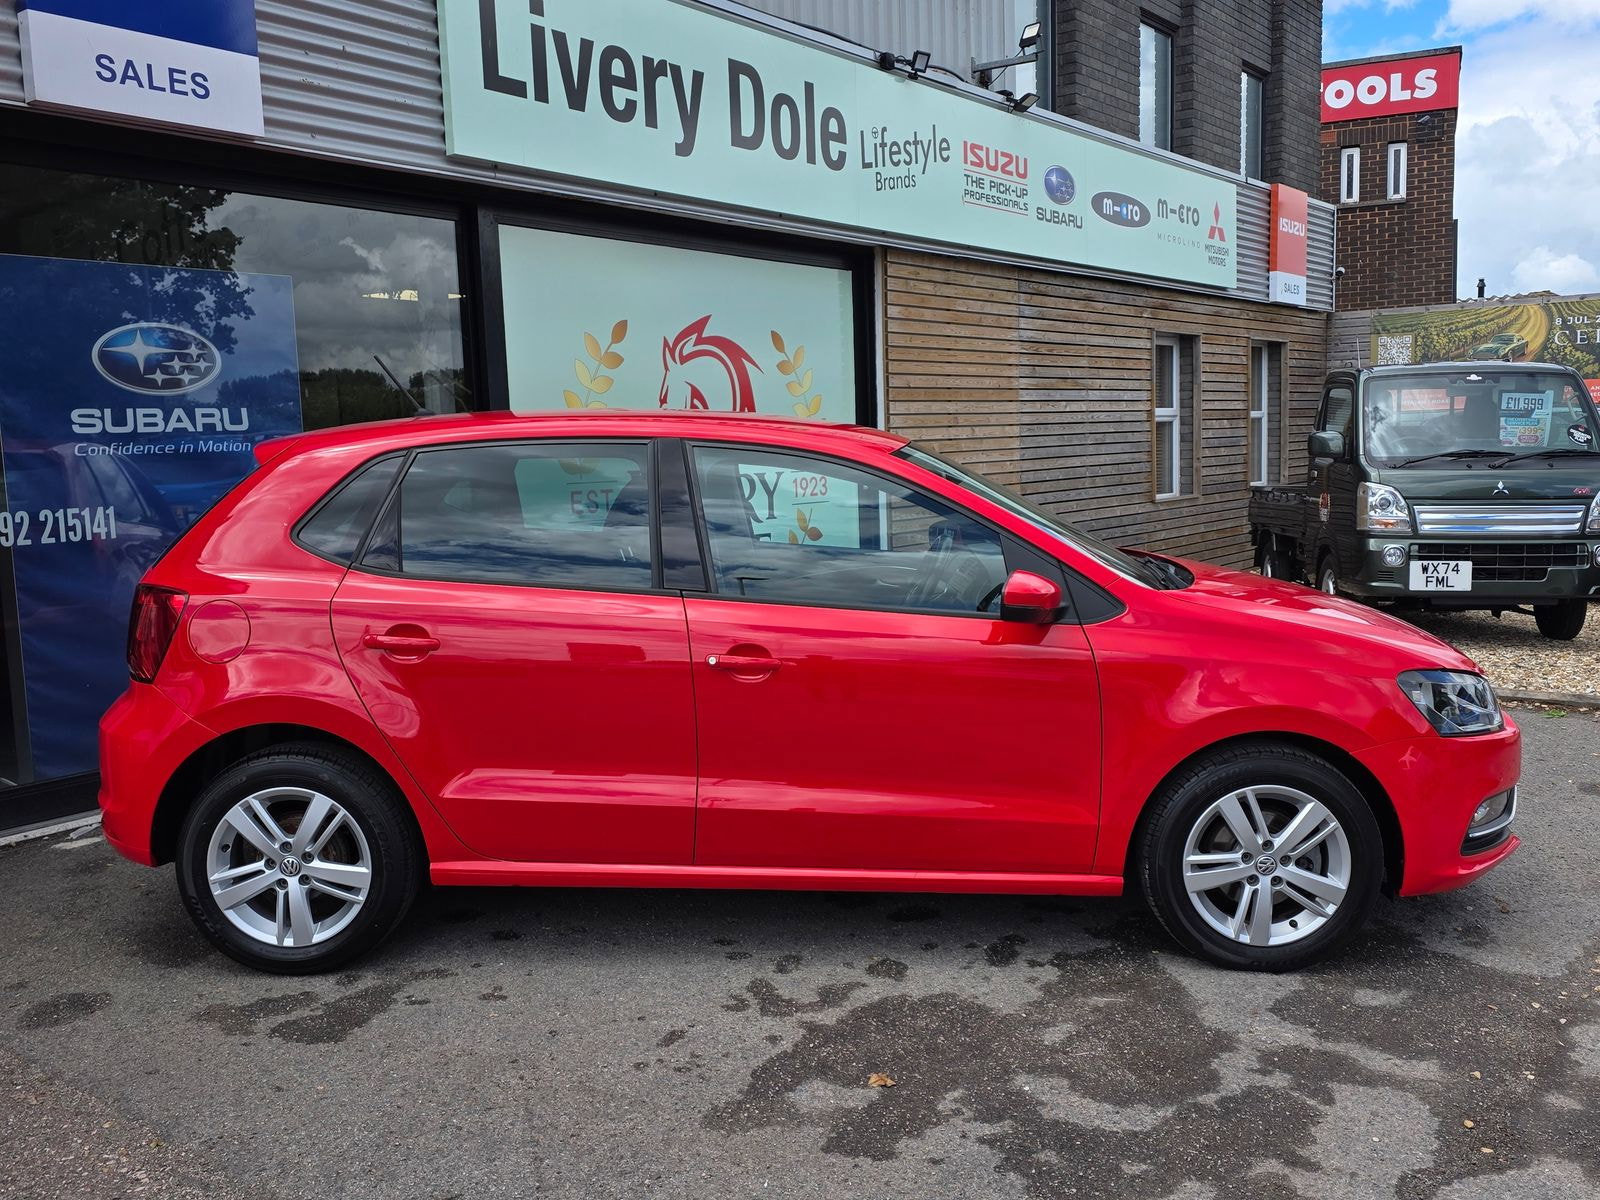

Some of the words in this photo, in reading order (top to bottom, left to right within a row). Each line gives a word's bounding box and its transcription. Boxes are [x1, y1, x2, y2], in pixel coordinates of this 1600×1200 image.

[95, 53, 211, 100] SALES
[478, 0, 705, 158] Livery
[727, 57, 848, 172] Dole
[1320, 68, 1438, 109] OOLS
[860, 124, 951, 175] Lifestyle
[963, 140, 1028, 180] ISUZU
[875, 168, 917, 192] Brands
[964, 173, 985, 190] THE
[989, 179, 1028, 200] PICK-UP
[963, 189, 1029, 212] PROFESSIONALS
[1036, 207, 1083, 230] SUBARU
[1279, 216, 1305, 237] ISUZU
[1207, 254, 1227, 268] MOTORS
[1283, 282, 1300, 296] SALES
[1567, 315, 1591, 325] JUL
[70, 407, 250, 434] SUBARU
[74, 441, 175, 457] Confidence
[179, 441, 194, 453] in
[197, 439, 251, 453] Motion
[792, 475, 829, 498] 1923
[570, 488, 614, 515] EST
[0, 510, 32, 547] 92
[38, 505, 117, 544] 215141
[1421, 562, 1461, 575] WX74
[1425, 575, 1455, 588] FML
